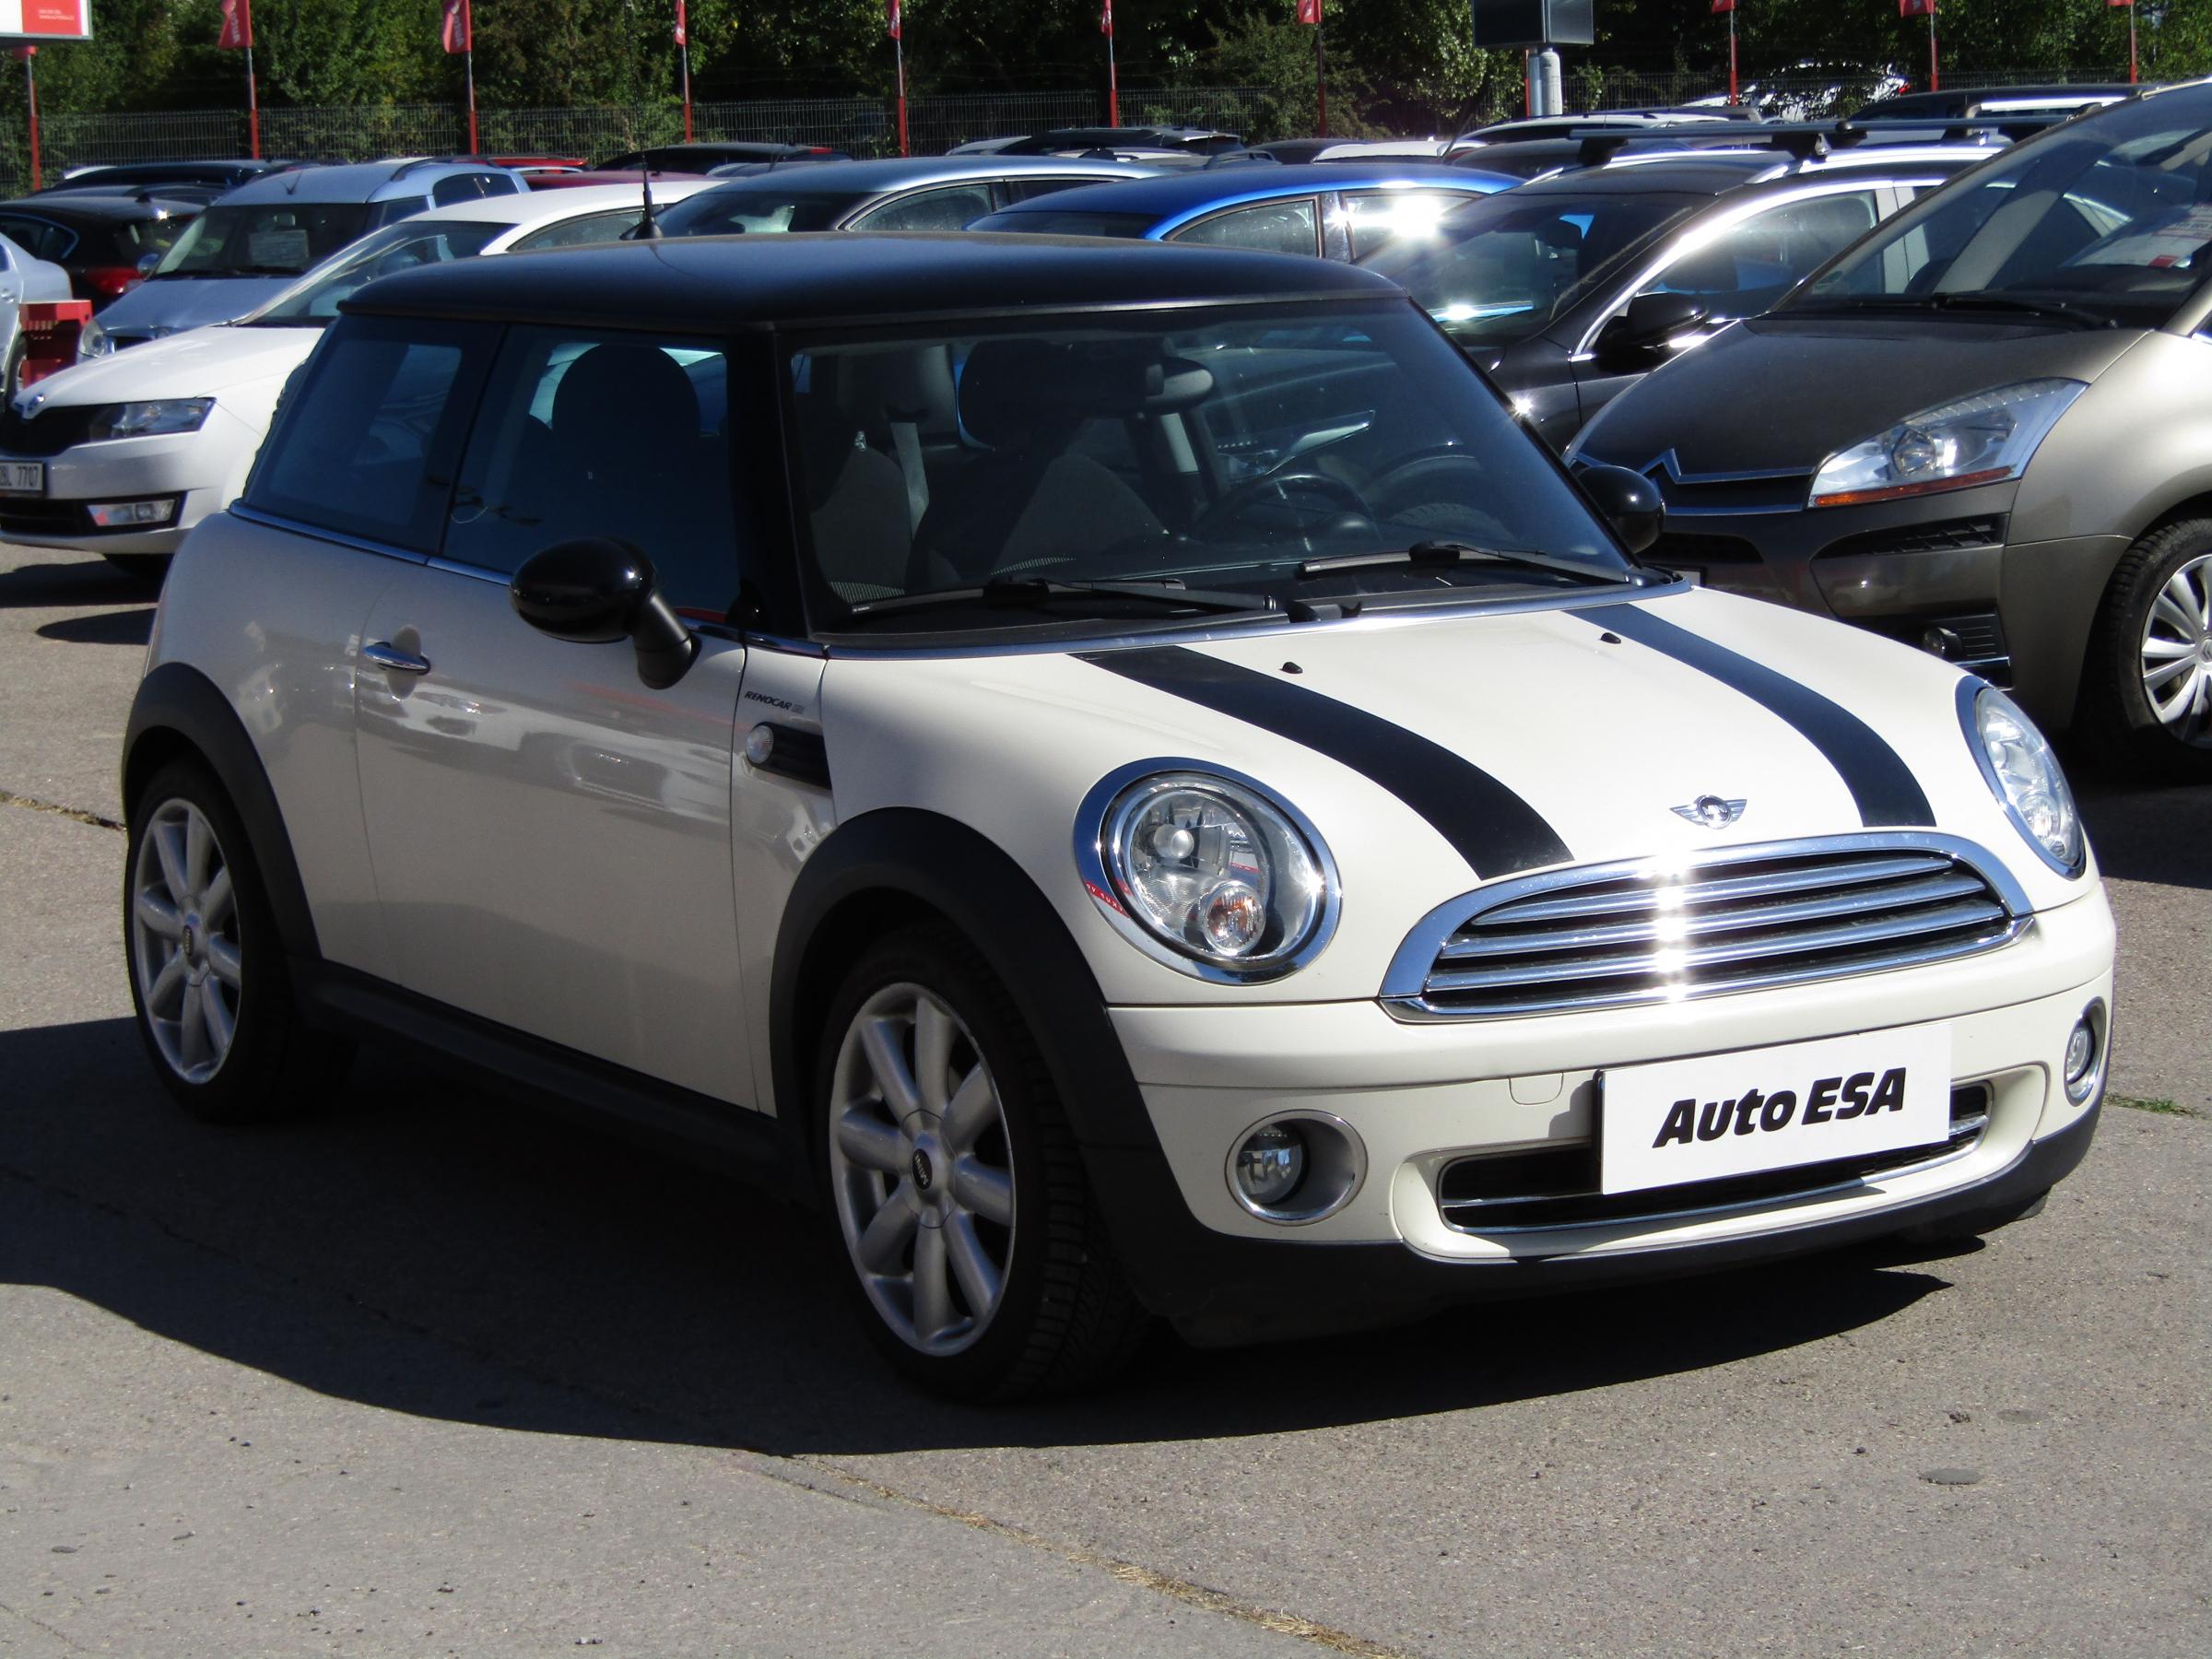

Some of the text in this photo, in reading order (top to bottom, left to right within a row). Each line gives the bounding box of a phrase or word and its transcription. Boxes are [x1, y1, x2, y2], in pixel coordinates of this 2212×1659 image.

[744, 690, 793, 711] RENOCAR
[1652, 1066, 1907, 1149] Auto ESA
[914, 1154, 929, 1185] MINI
